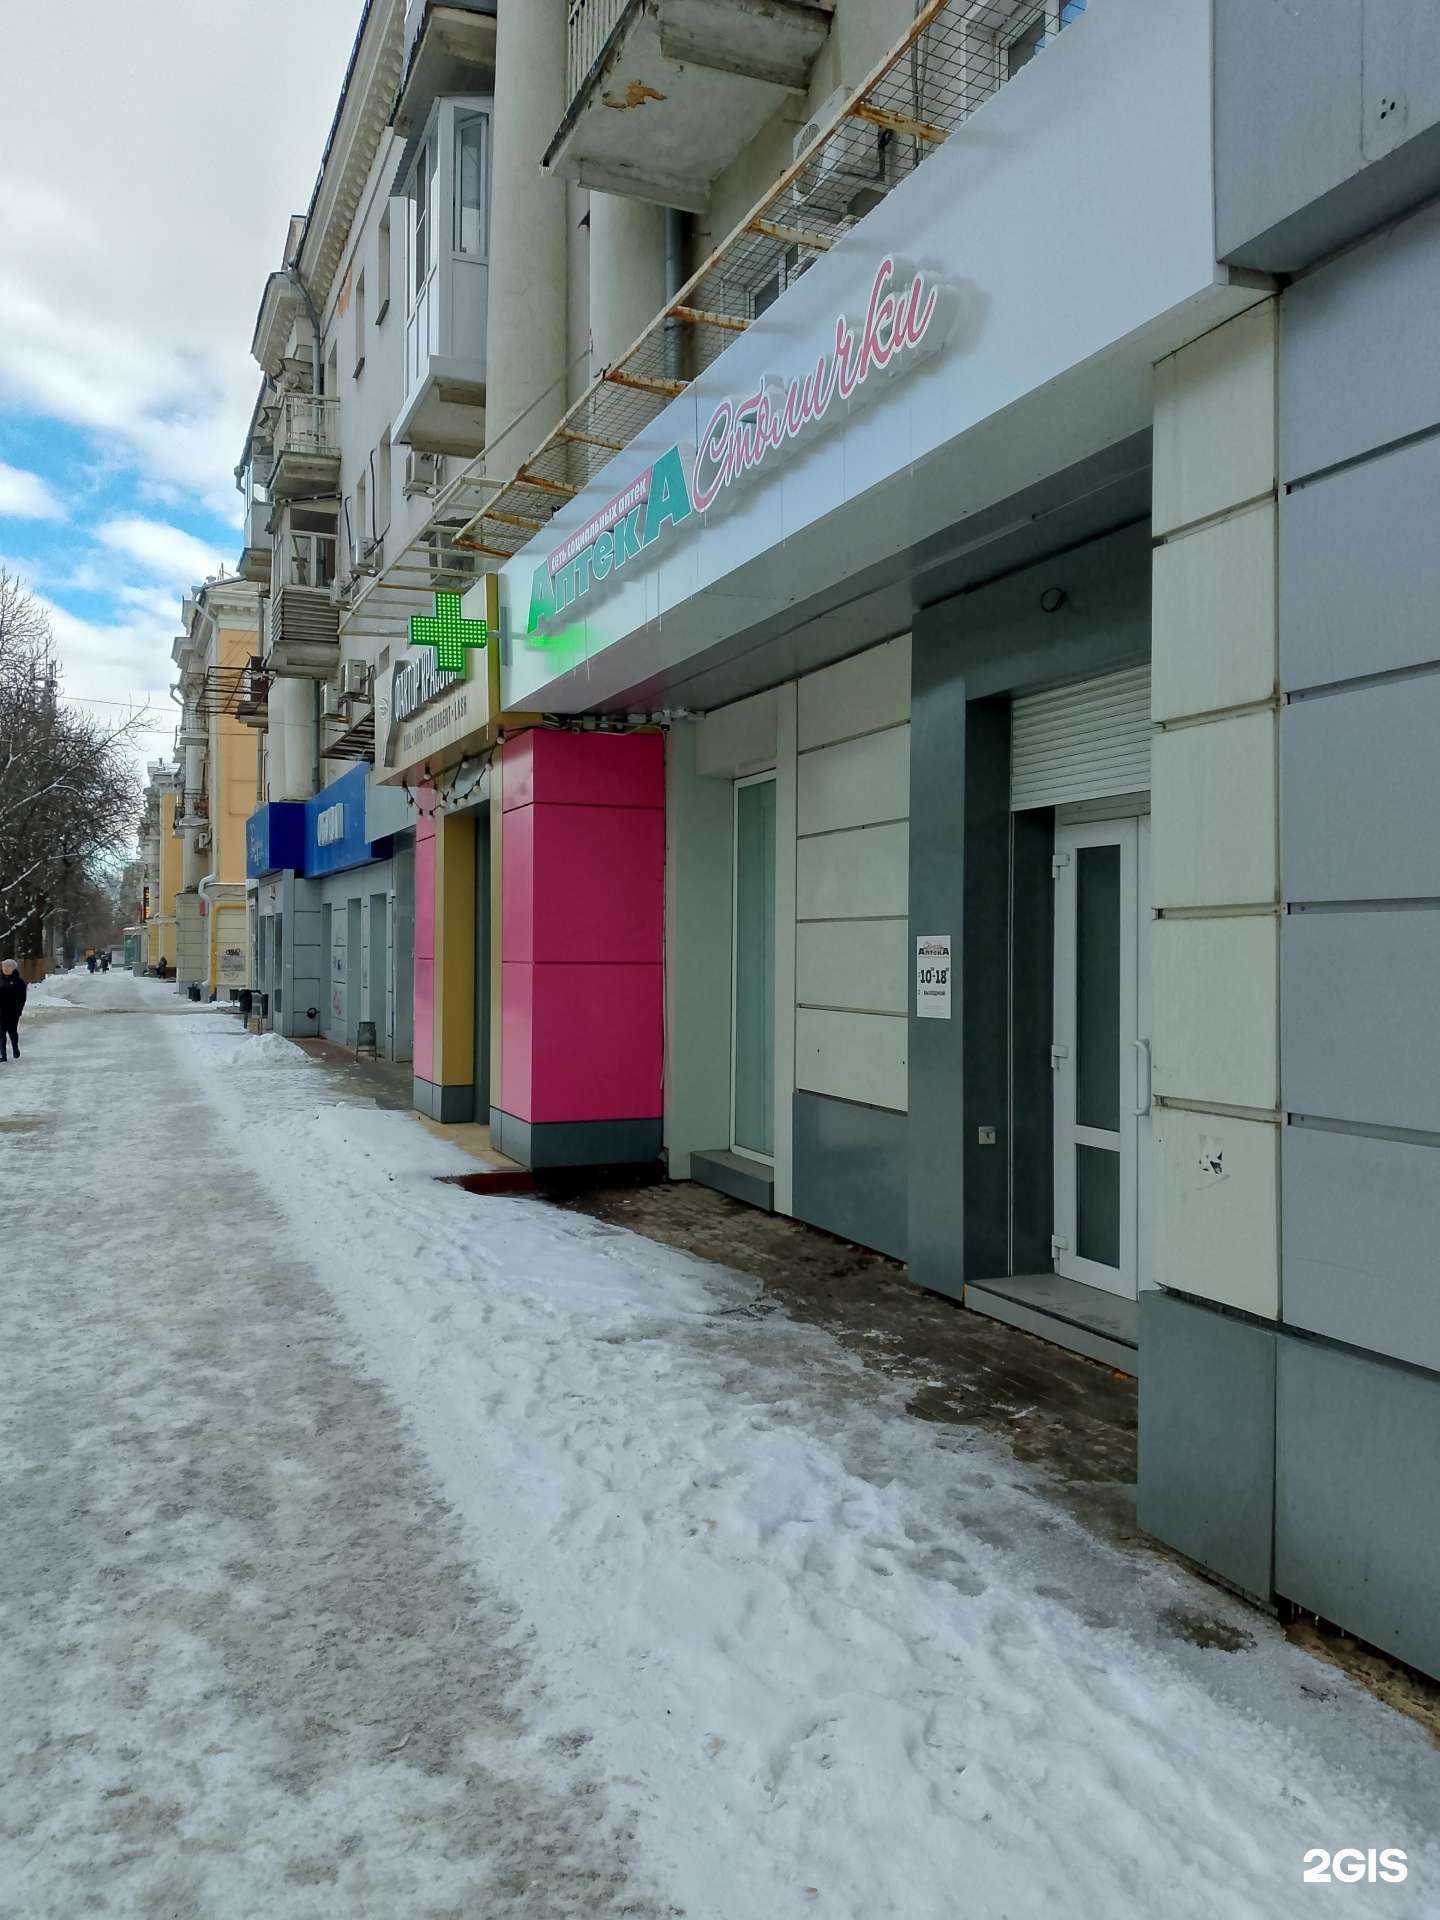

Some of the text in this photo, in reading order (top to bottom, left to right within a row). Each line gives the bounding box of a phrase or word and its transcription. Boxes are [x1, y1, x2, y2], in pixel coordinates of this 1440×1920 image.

[692, 253, 937, 512] Столички
[568, 503, 617, 556] социальных
[619, 478, 646, 514] аптек
